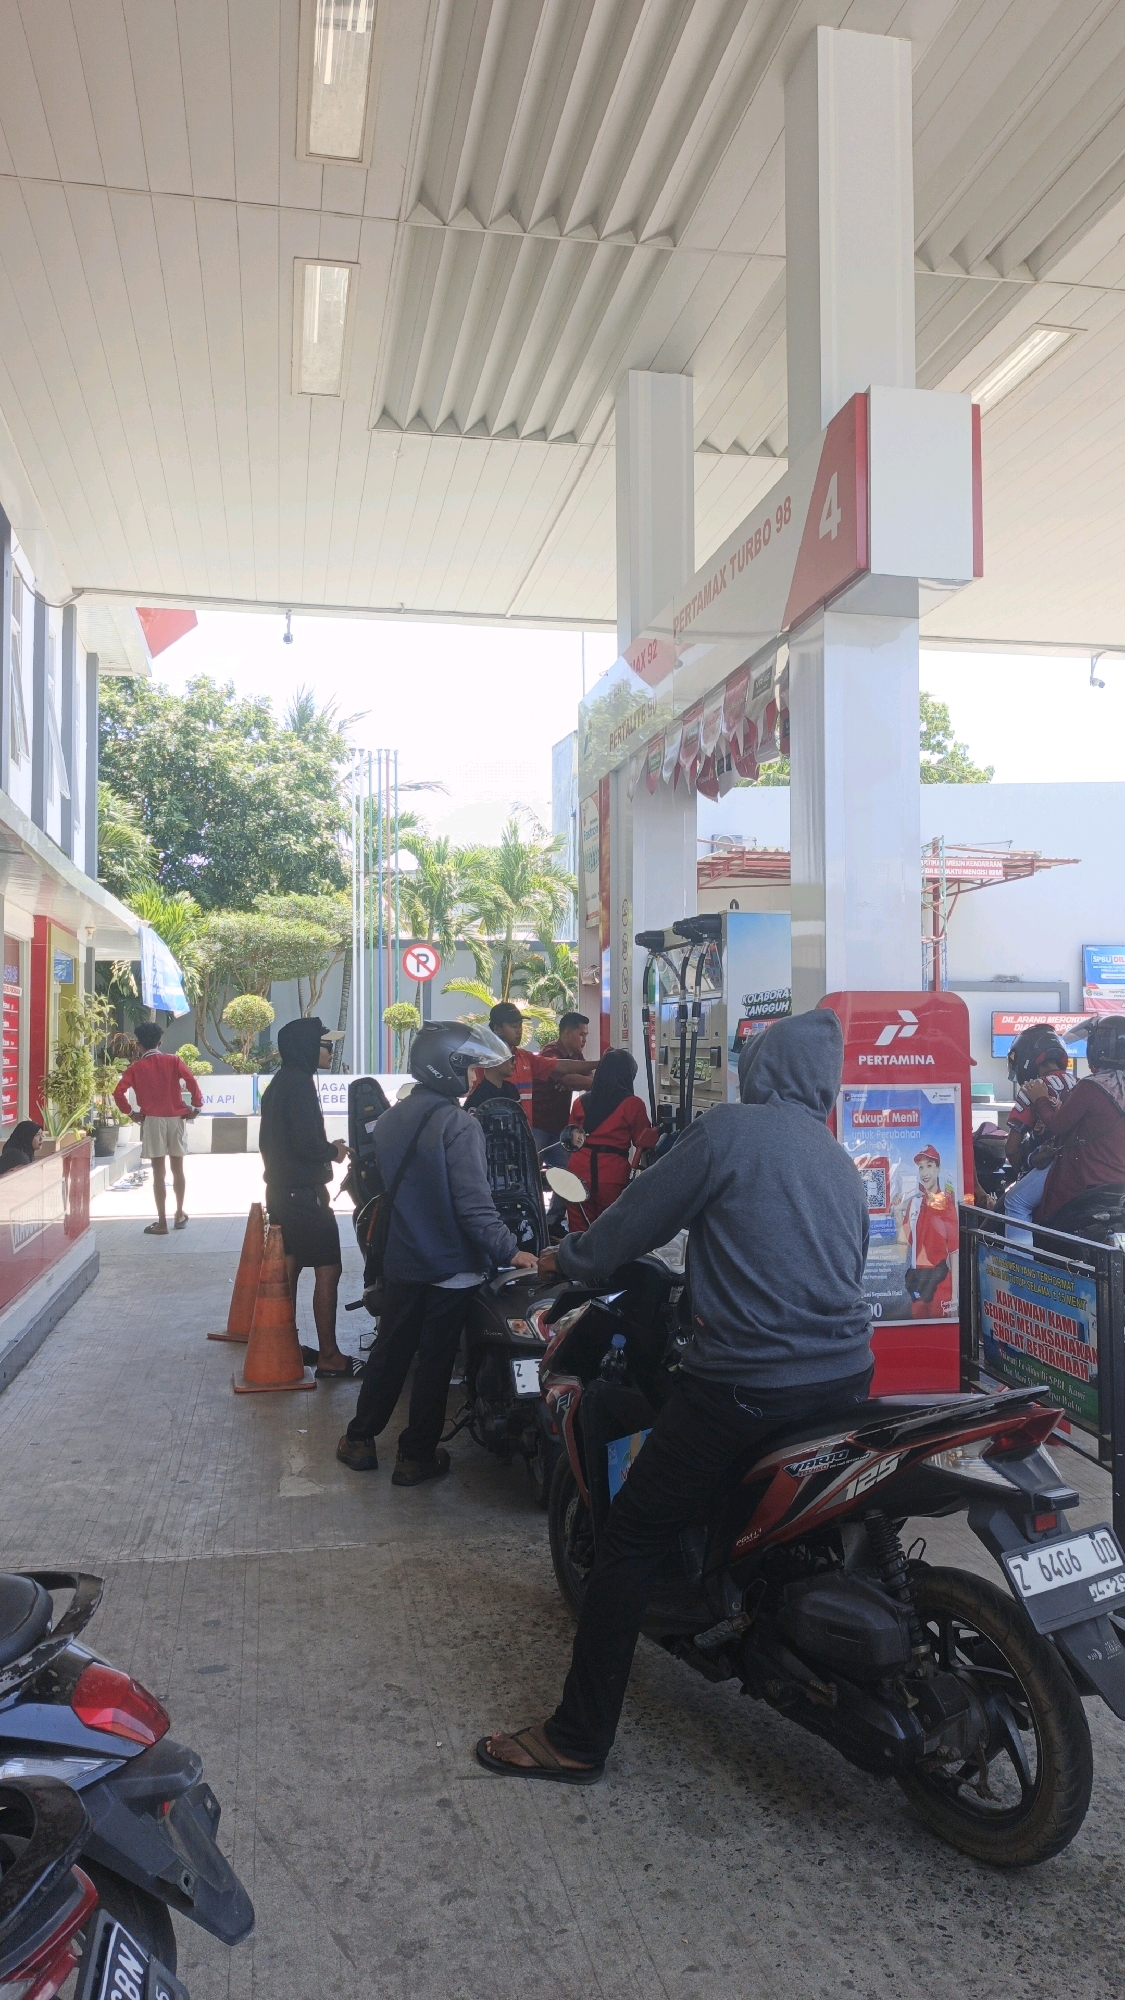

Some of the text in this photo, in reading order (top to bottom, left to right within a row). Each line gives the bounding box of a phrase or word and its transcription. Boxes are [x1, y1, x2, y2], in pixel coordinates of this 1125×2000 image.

[820, 470, 842, 541] 4
[673, 496, 792, 639] PERTAMAX TURBO 98
[648, 638, 658, 664] 92
[610, 704, 646, 752] PERTALITE
[745, 1001, 789, 1016] TANGGUH
[858, 1054, 935, 1066] PERTAMINA
[217, 1095, 235, 1104] API
[853, 1113, 883, 1125] Cukup
[892, 1111, 918, 1122] Menit
[852, 1130, 920, 1140] untuk Perubahan
[1021, 1264, 1036, 1278] YANG
[1037, 1270, 1075, 1291] TERHORMAT
[1009, 1274, 1026, 1287] TUTUP
[1027, 1281, 1050, 1297] SELAMA
[1058, 1292, 1065, 1303] 15
[1067, 1294, 1087, 1311] MENIT
[996, 1290, 1078, 1336] KARYAWAN KAMI
[984, 1301, 1014, 1328] SEDANG
[1016, 1316, 1098, 1364] MELAKSANAKAN
[993, 1322, 1089, 1382] SHOLAT BERJAMAAH
[516, 1364, 523, 1377] Z
[1042, 1371, 1048, 1381] Di
[1068, 1384, 1086, 1401] Kami
[1062, 1395, 1081, 1413] Waktu
[783, 1449, 850, 1477] VARIO
[846, 1456, 900, 1501] 125
[1013, 1537, 1116, 1590] Z 6406 UD
